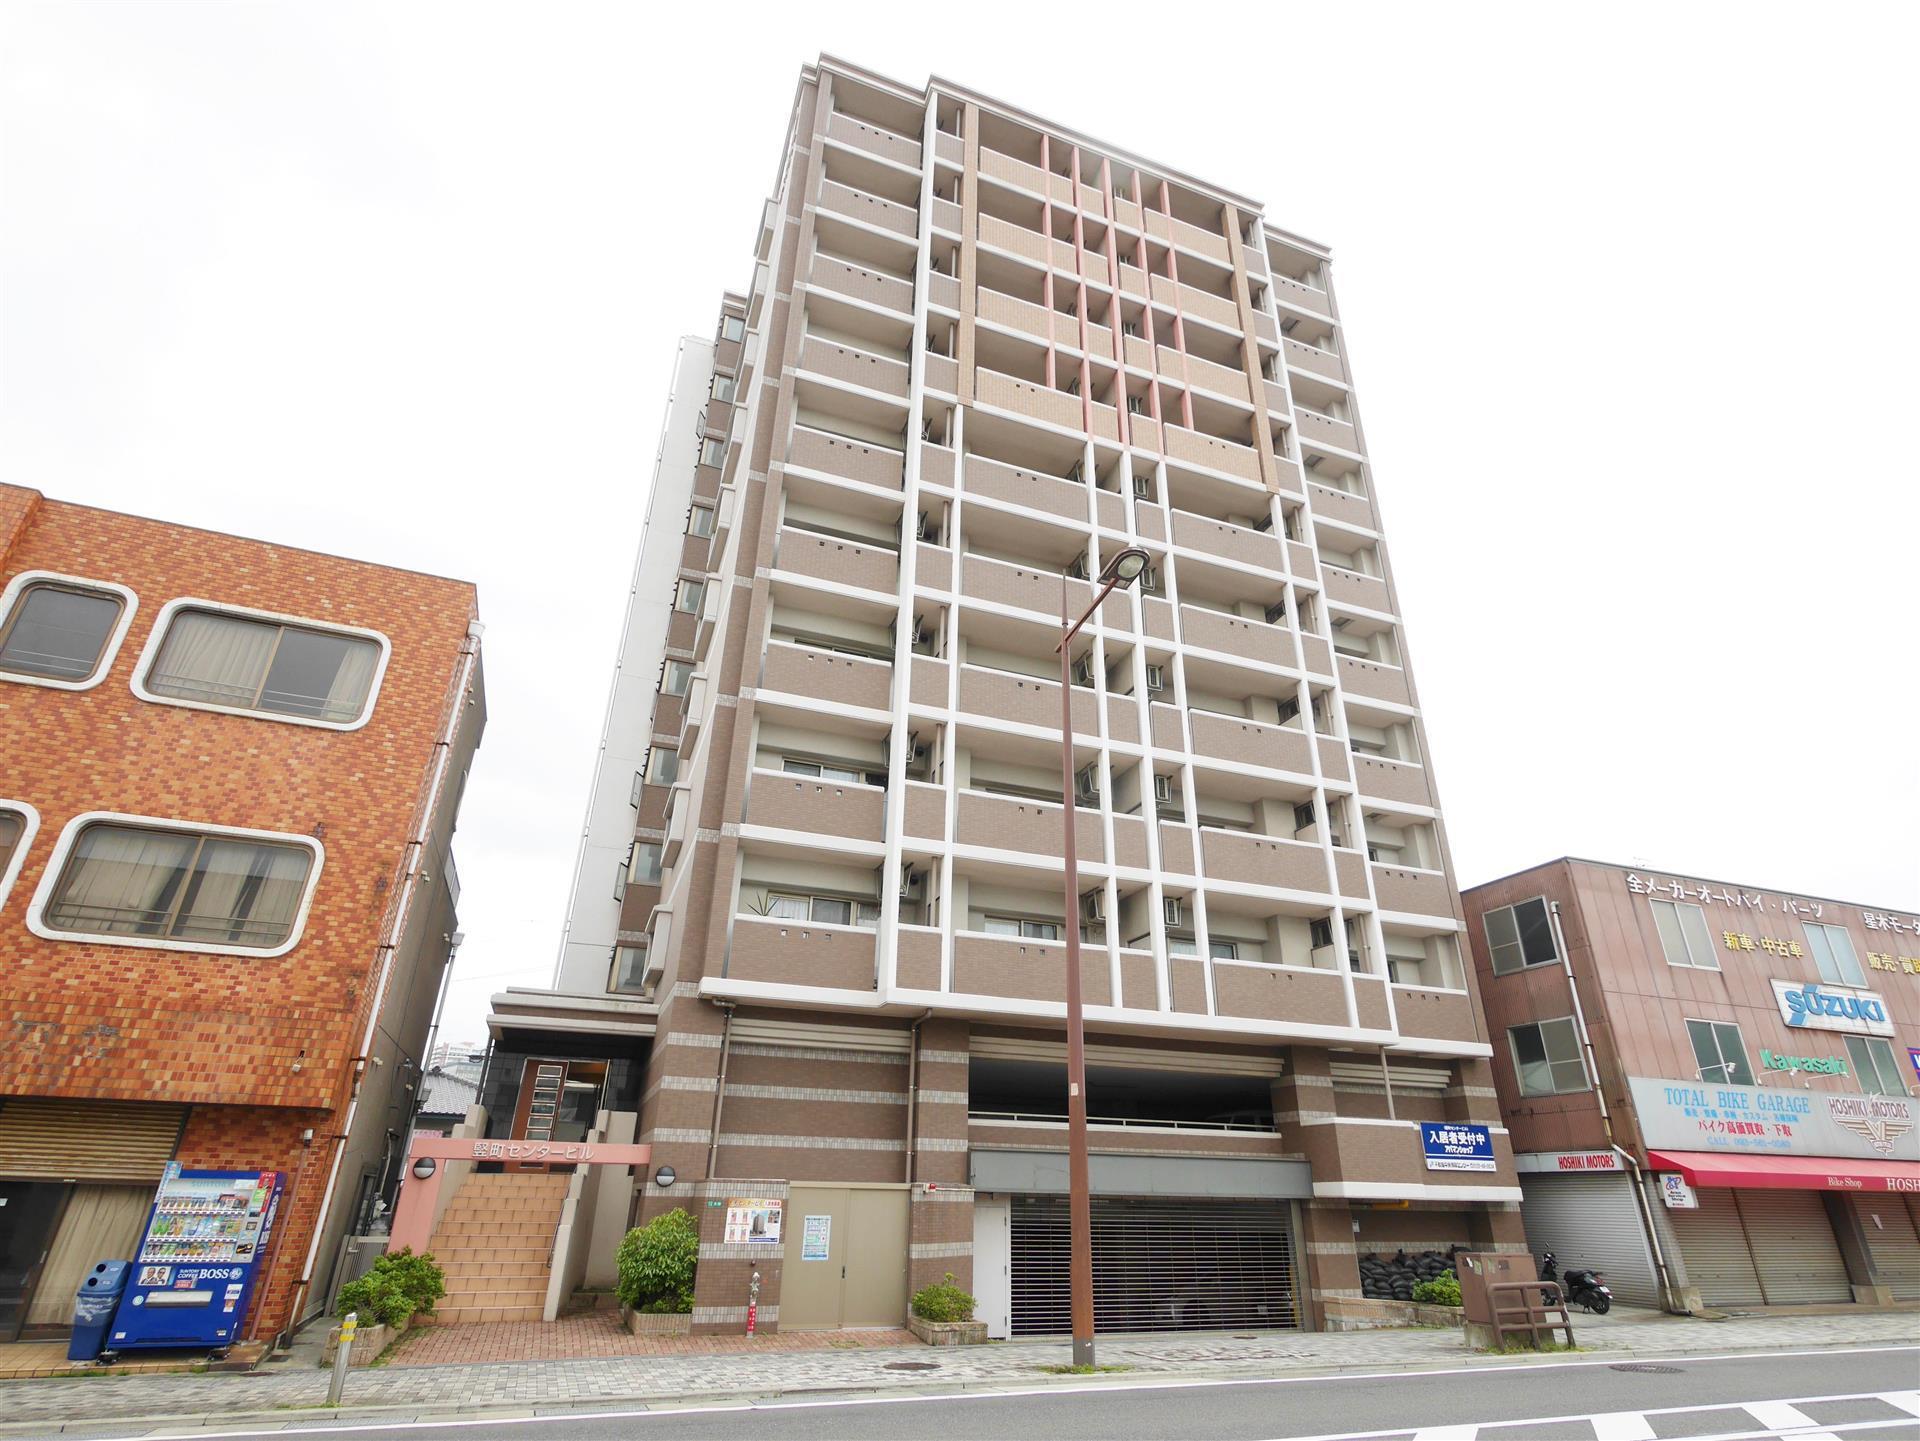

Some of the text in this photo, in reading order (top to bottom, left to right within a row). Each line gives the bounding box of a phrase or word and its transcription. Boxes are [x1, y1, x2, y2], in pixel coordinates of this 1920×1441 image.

[1722, 929, 1804, 958] 新車・中古車
[1784, 988, 1886, 1023] SUZUKI
[1759, 1048, 1849, 1075] Kawasaki
[1664, 1087, 1811, 1114] TOTAL BIKE GARAGE
[1827, 1096, 1910, 1119] HOSHIKI MOTORS
[1429, 1130, 1486, 1146] 入居者受付中
[1558, 1154, 1615, 1169] HOSHIKI MOTORS
[1827, 1176, 1844, 1187] Bike
[1844, 1177, 1863, 1189] Shop
[198, 1269, 230, 1279] BOSS
